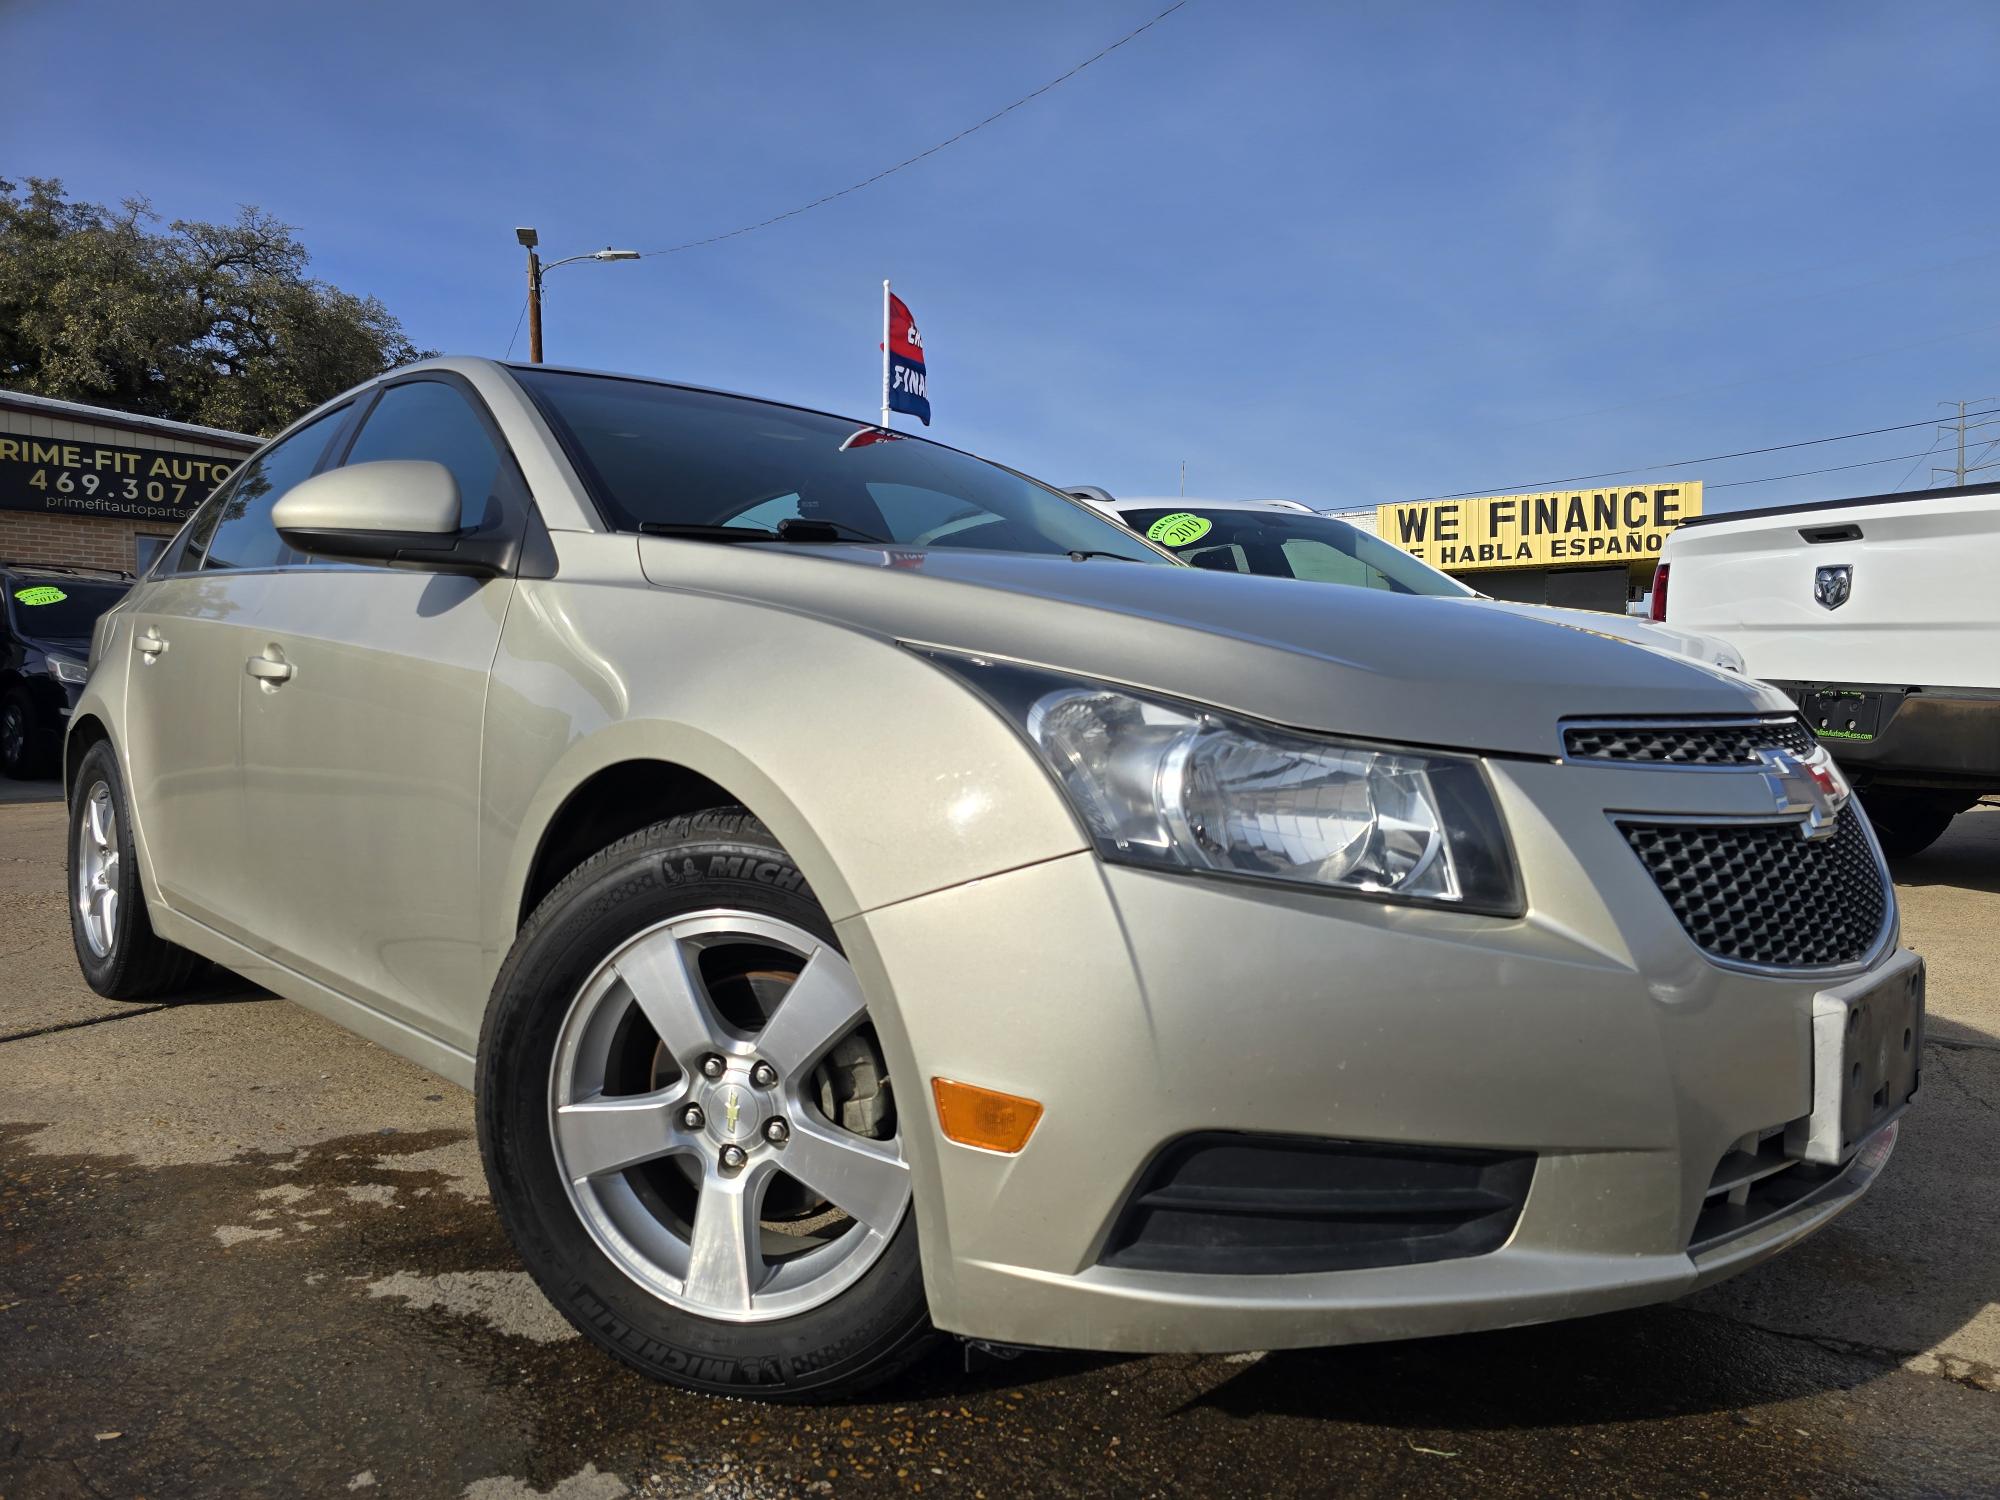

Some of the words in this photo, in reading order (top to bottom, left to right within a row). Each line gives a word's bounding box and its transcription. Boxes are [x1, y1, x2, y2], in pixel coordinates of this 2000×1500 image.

[149, 457, 233, 484] AUTO
[1152, 522, 1166, 539] EXTRA
[1164, 513, 1190, 524] CLEAN
[1397, 505, 1459, 543] WE
[1489, 489, 1680, 538] FINANCE
[1169, 520, 1202, 543] 2019
[1441, 542, 1533, 563] HABLA
[1551, 531, 1670, 557] ESPAÑO
[34, 594, 60, 605] 2016
[569, 1292, 736, 1384] MICHELIN
